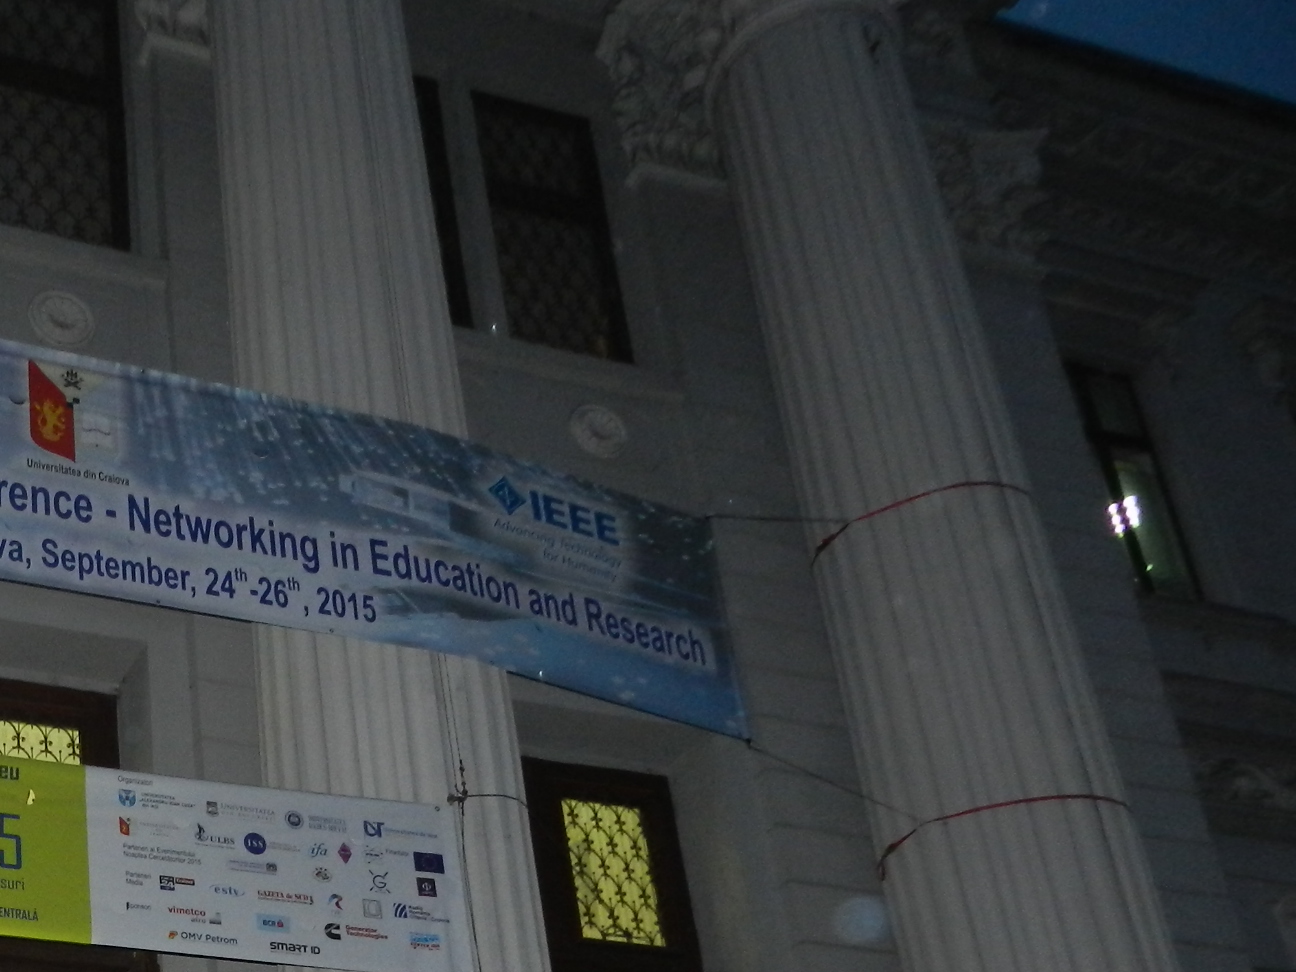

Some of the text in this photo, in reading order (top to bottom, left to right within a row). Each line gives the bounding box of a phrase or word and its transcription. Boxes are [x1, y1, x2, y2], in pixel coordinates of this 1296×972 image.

[26, 457, 131, 487] Universitatea din Craiova
[528, 489, 621, 547] IEEE
[40, 537, 199, 598] September,
[316, 586, 378, 624] 2015
[128, 495, 320, 574] Networking
[330, 527, 360, 573] in
[370, 538, 521, 611] Education
[529, 585, 578, 629] and
[584, 598, 707, 669] Research
[210, 835, 236, 846] ULBS
[246, 838, 265, 849] ISS
[310, 842, 329, 858] ifa
[257, 889, 285, 899] GAZETA
[167, 905, 207, 917] vimetco
[180, 931, 238, 946] OMV Petrom
[310, 945, 322, 955] ID
